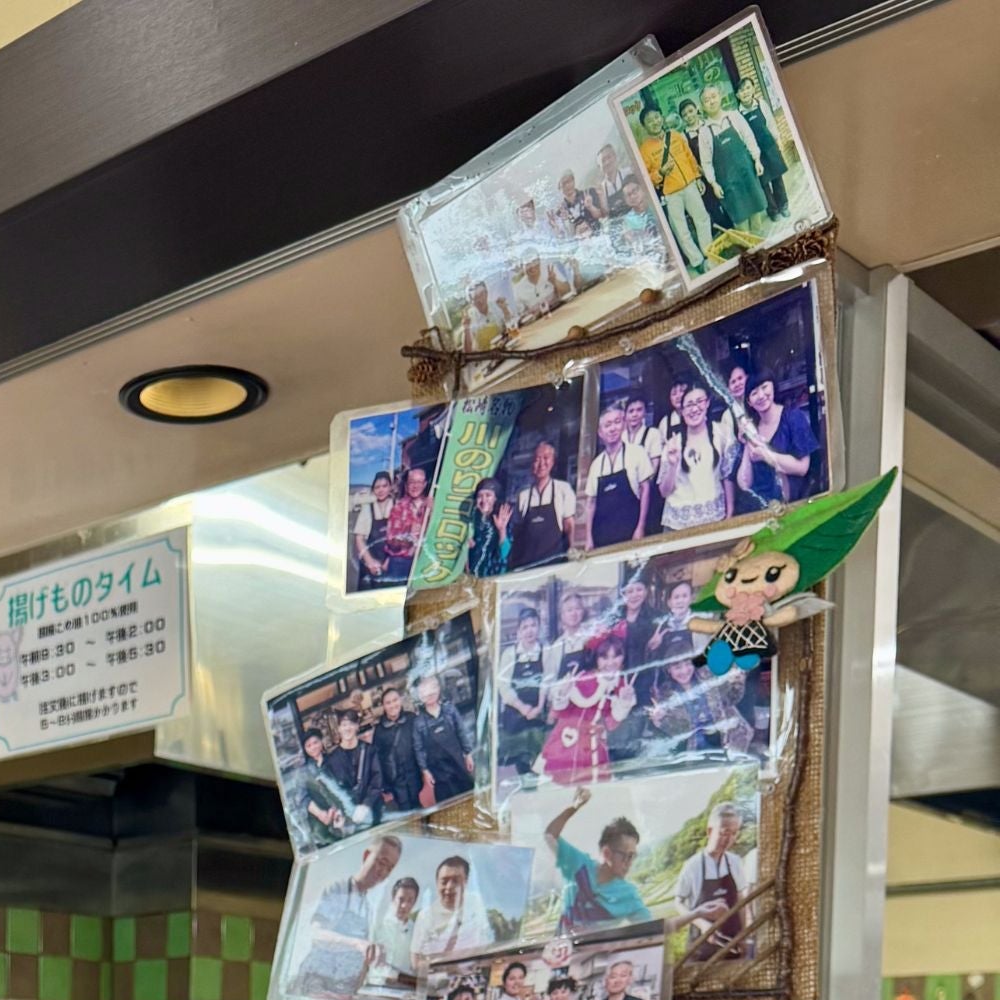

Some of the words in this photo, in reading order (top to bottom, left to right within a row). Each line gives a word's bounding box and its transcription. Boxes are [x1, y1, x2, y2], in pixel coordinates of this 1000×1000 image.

[7, 557, 162, 628] 揚げものタイム
